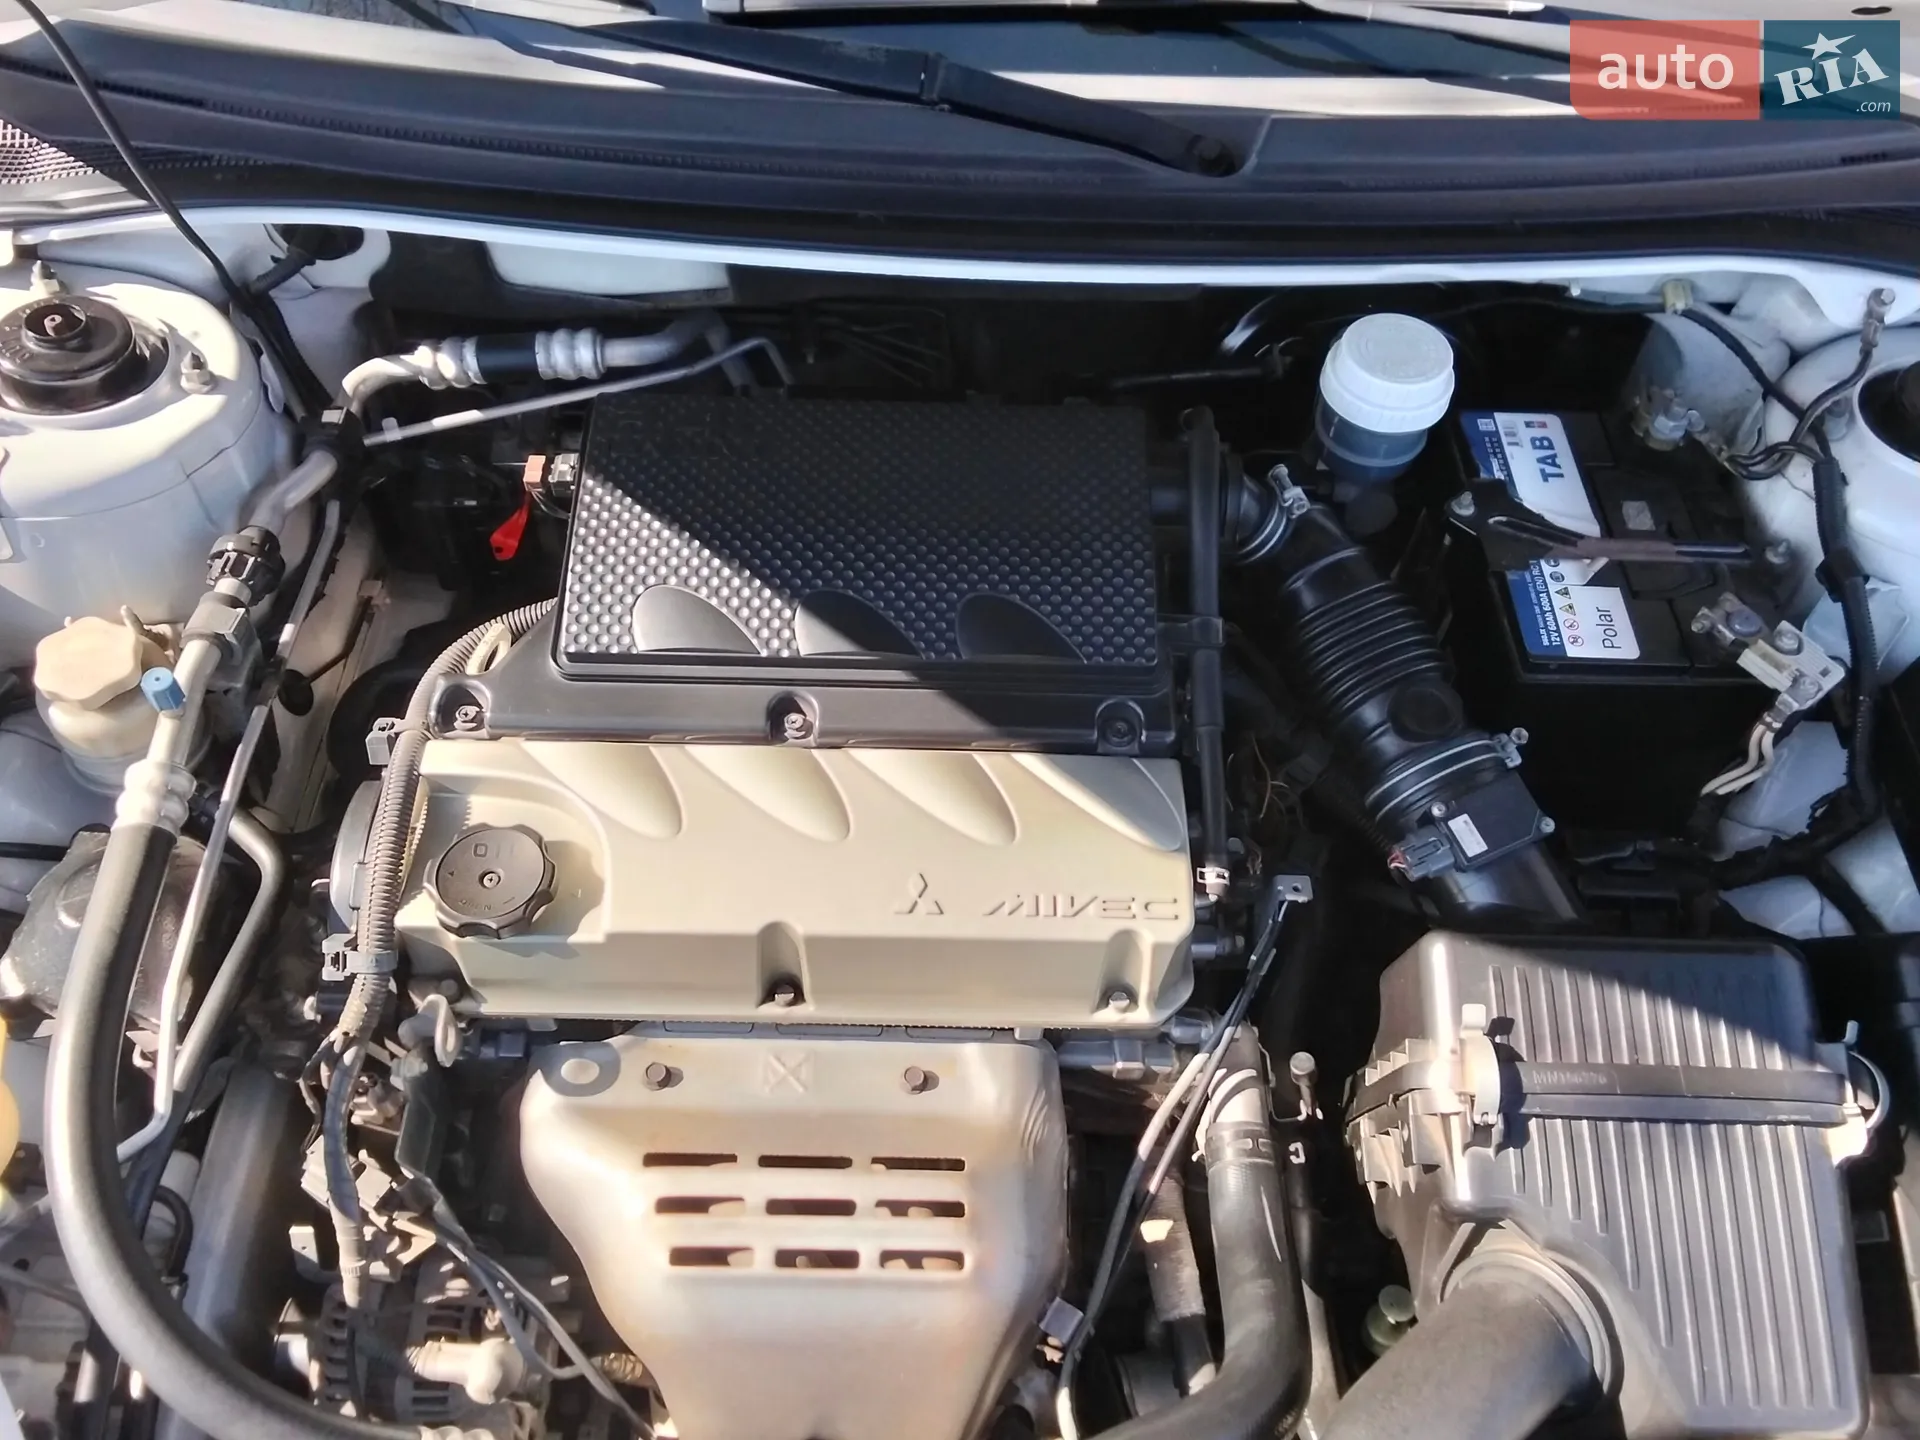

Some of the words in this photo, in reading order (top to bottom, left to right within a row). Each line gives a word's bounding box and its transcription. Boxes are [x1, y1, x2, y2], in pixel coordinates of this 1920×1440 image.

[1529, 436, 1565, 483] TAB
[1539, 592, 1553, 612] 600A
[1544, 611, 1557, 631] 60Ah
[1595, 606, 1622, 650] Polar
[1549, 631, 1561, 646] 12V
[983, 893, 1180, 921] MIVEC
